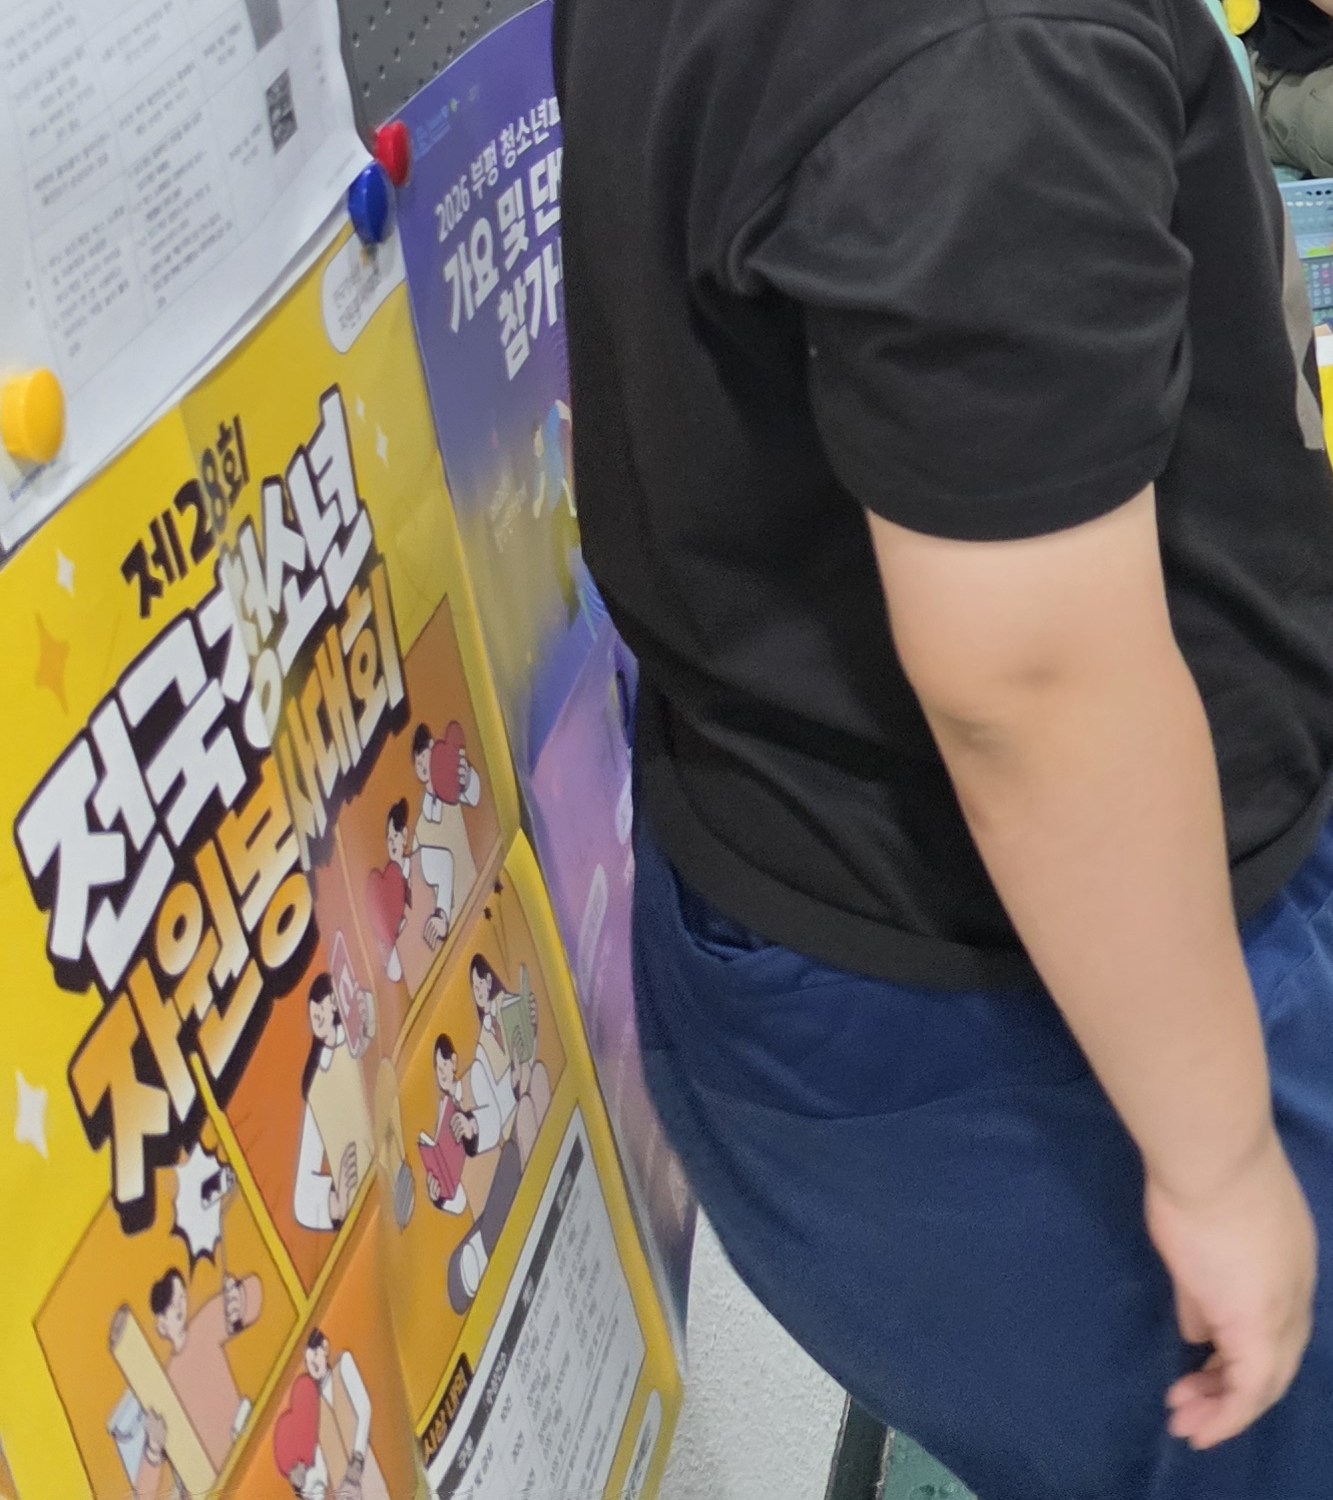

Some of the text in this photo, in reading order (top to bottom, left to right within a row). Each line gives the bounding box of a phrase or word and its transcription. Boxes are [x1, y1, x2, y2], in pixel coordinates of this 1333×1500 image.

[434, 175, 471, 243] 2026
[470, 139, 500, 200] 부평
[444, 217, 500, 335] 가요
[497, 177, 530, 272] 및
[119, 415, 250, 619] 제28회
